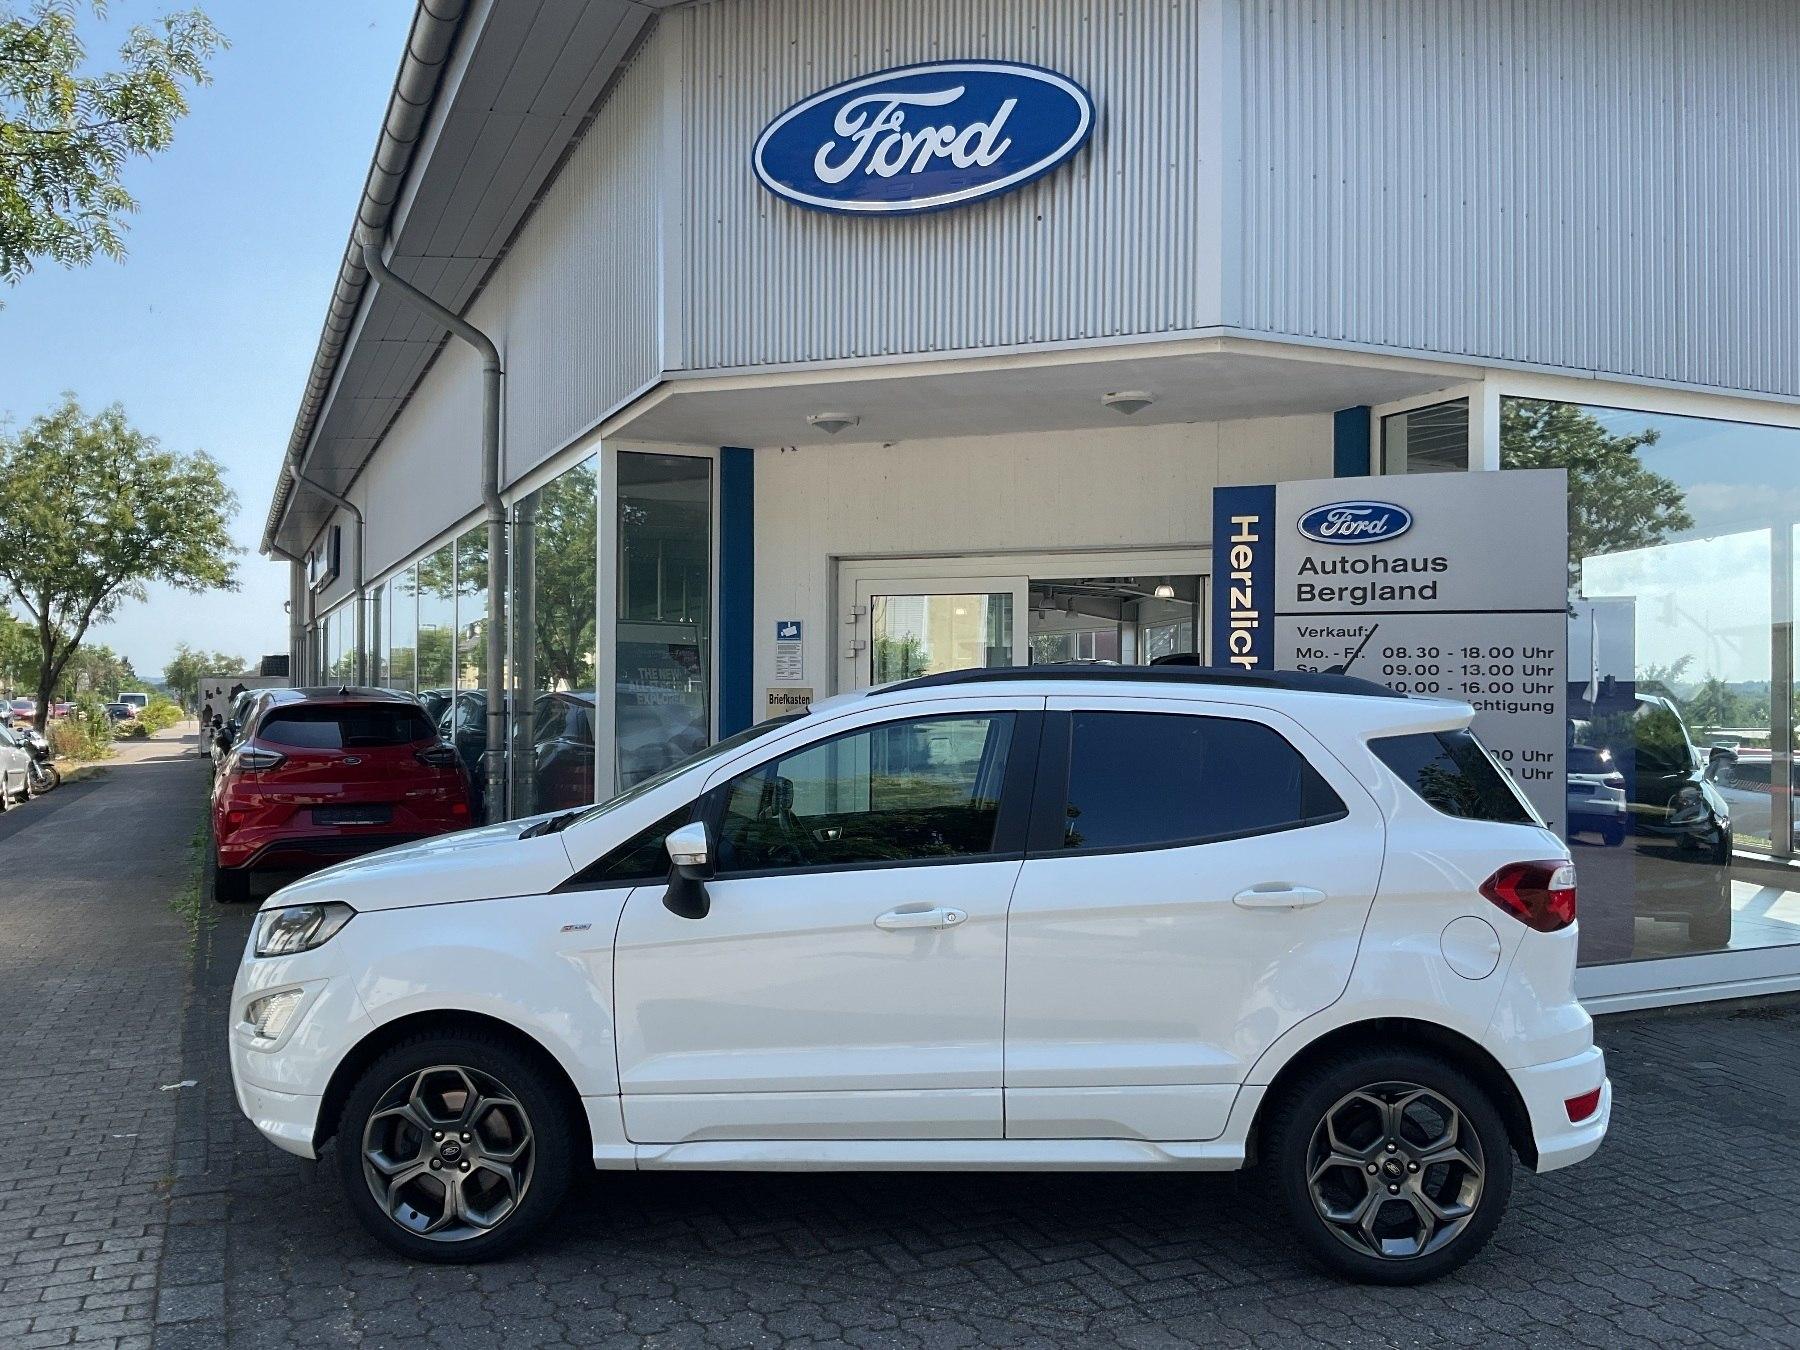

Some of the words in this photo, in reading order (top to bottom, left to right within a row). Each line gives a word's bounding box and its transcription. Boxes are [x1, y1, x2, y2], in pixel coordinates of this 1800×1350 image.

[814, 85, 1018, 184] Ford
[1319, 508, 1390, 537] Ford
[1297, 554, 1448, 576] Autohaus
[1296, 580, 1438, 606] Bergland
[1296, 625, 1370, 638] Verkauf:
[1296, 647, 1329, 659] Mo.
[1382, 646, 1440, 659] 08.30
[1460, 646, 1515, 659] 18.00
[1522, 647, 1555, 659] Uhr
[1382, 664, 1440, 676] 09.00
[1460, 664, 1515, 677] 13.00
[1522, 665, 1555, 677] Uhr
[1460, 681, 1515, 694] 16.00
[1522, 682, 1555, 694] Uhr
[769, 693, 810, 705] Briefkasten
[1467, 699, 1555, 715] chtigung
[1522, 750, 1554, 762] Uhr
[1521, 767, 1554, 780] Uhr
